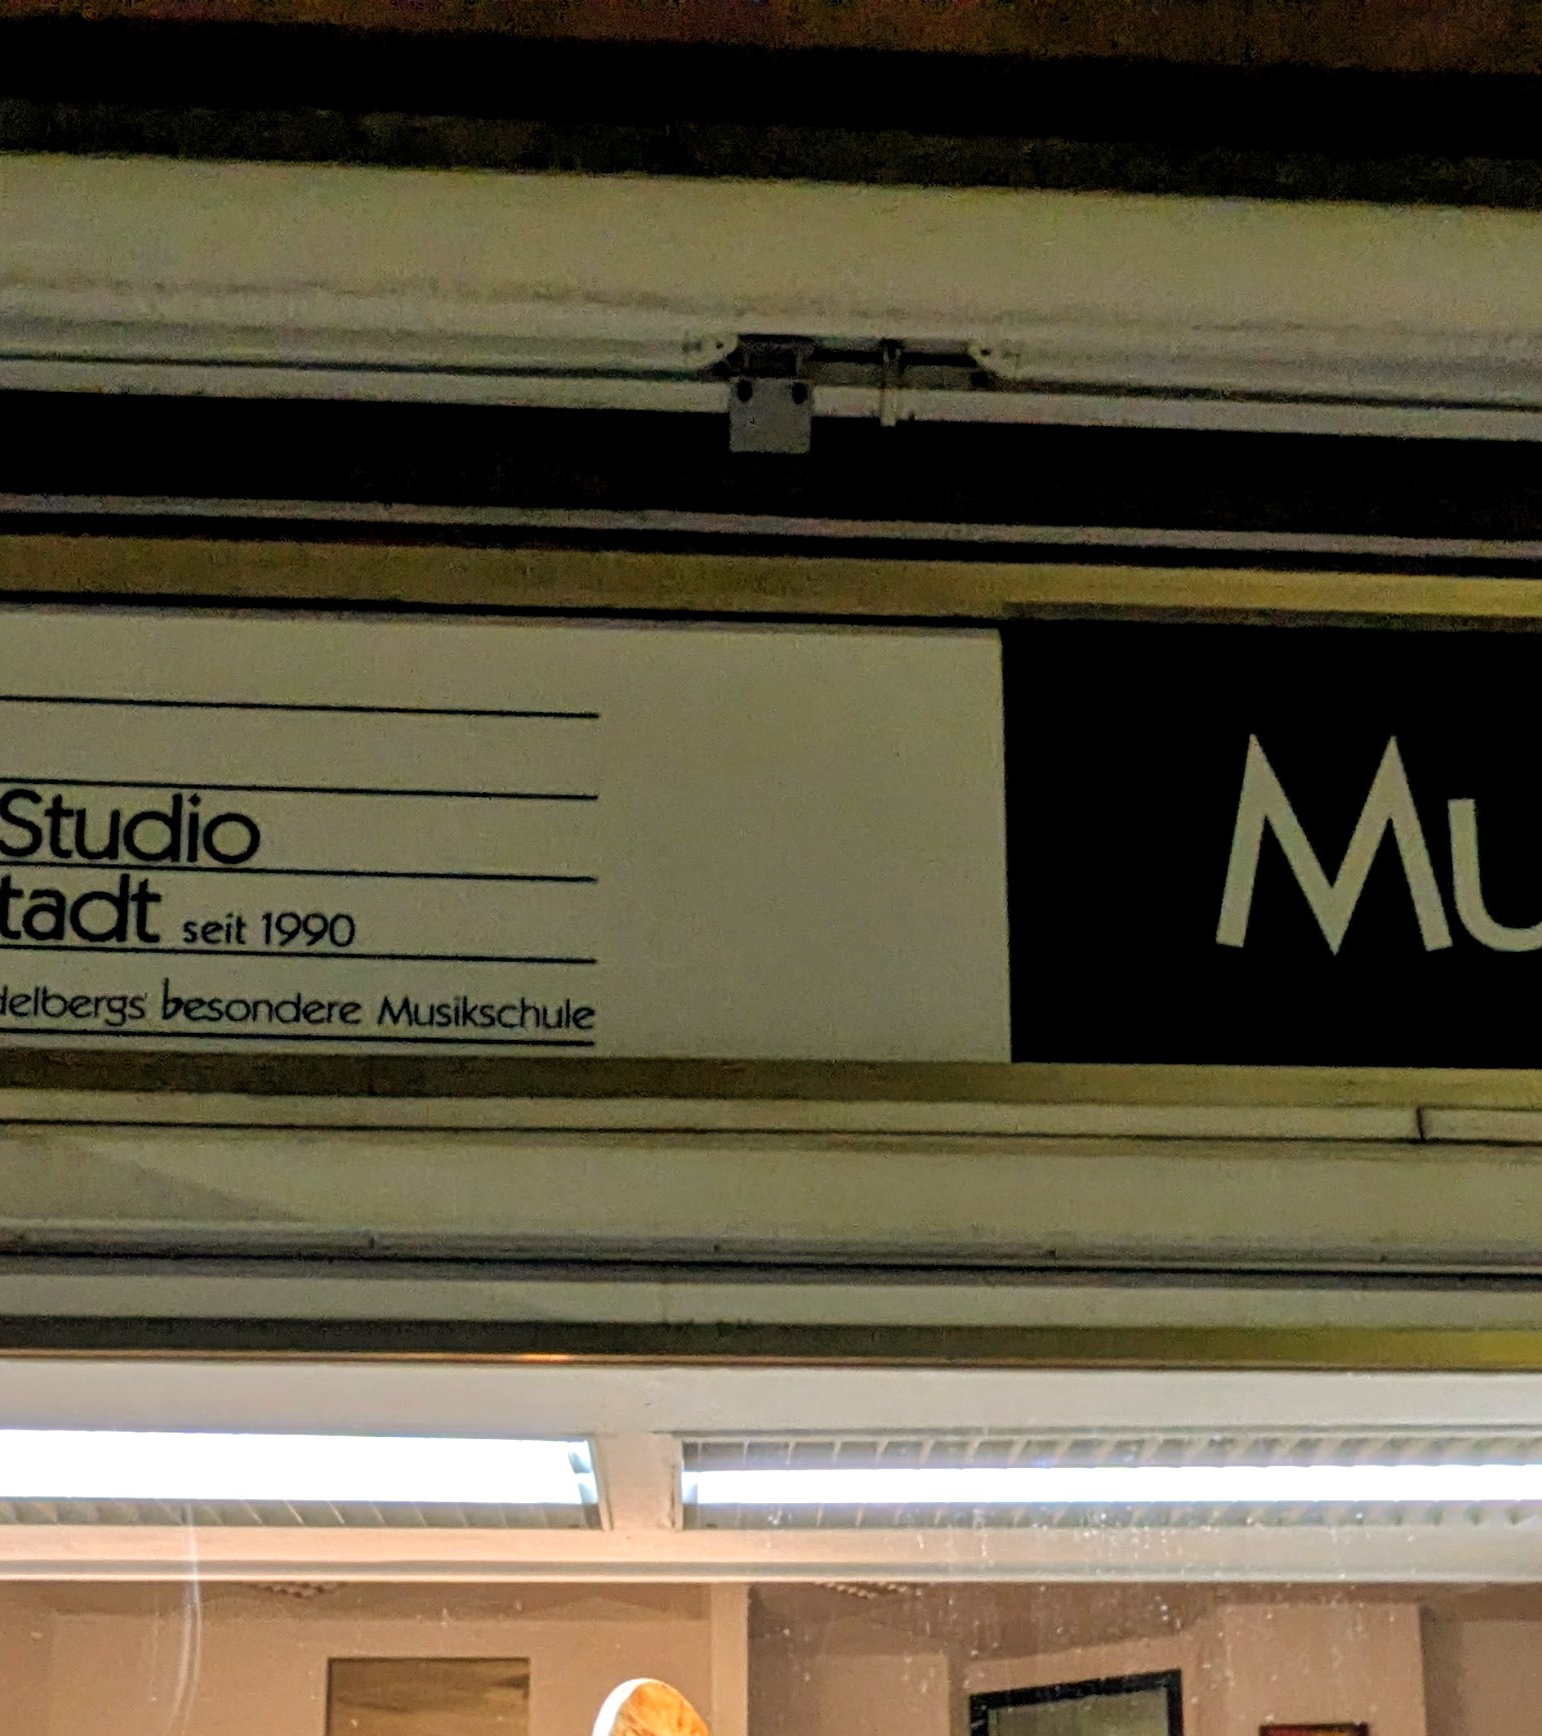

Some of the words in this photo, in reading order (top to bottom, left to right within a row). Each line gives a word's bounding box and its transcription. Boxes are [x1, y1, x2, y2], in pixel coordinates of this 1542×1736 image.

[180, 914, 251, 948] seit
[260, 912, 357, 949] 1990
[162, 980, 363, 1028] besondere
[376, 994, 597, 1032] Musikschule
